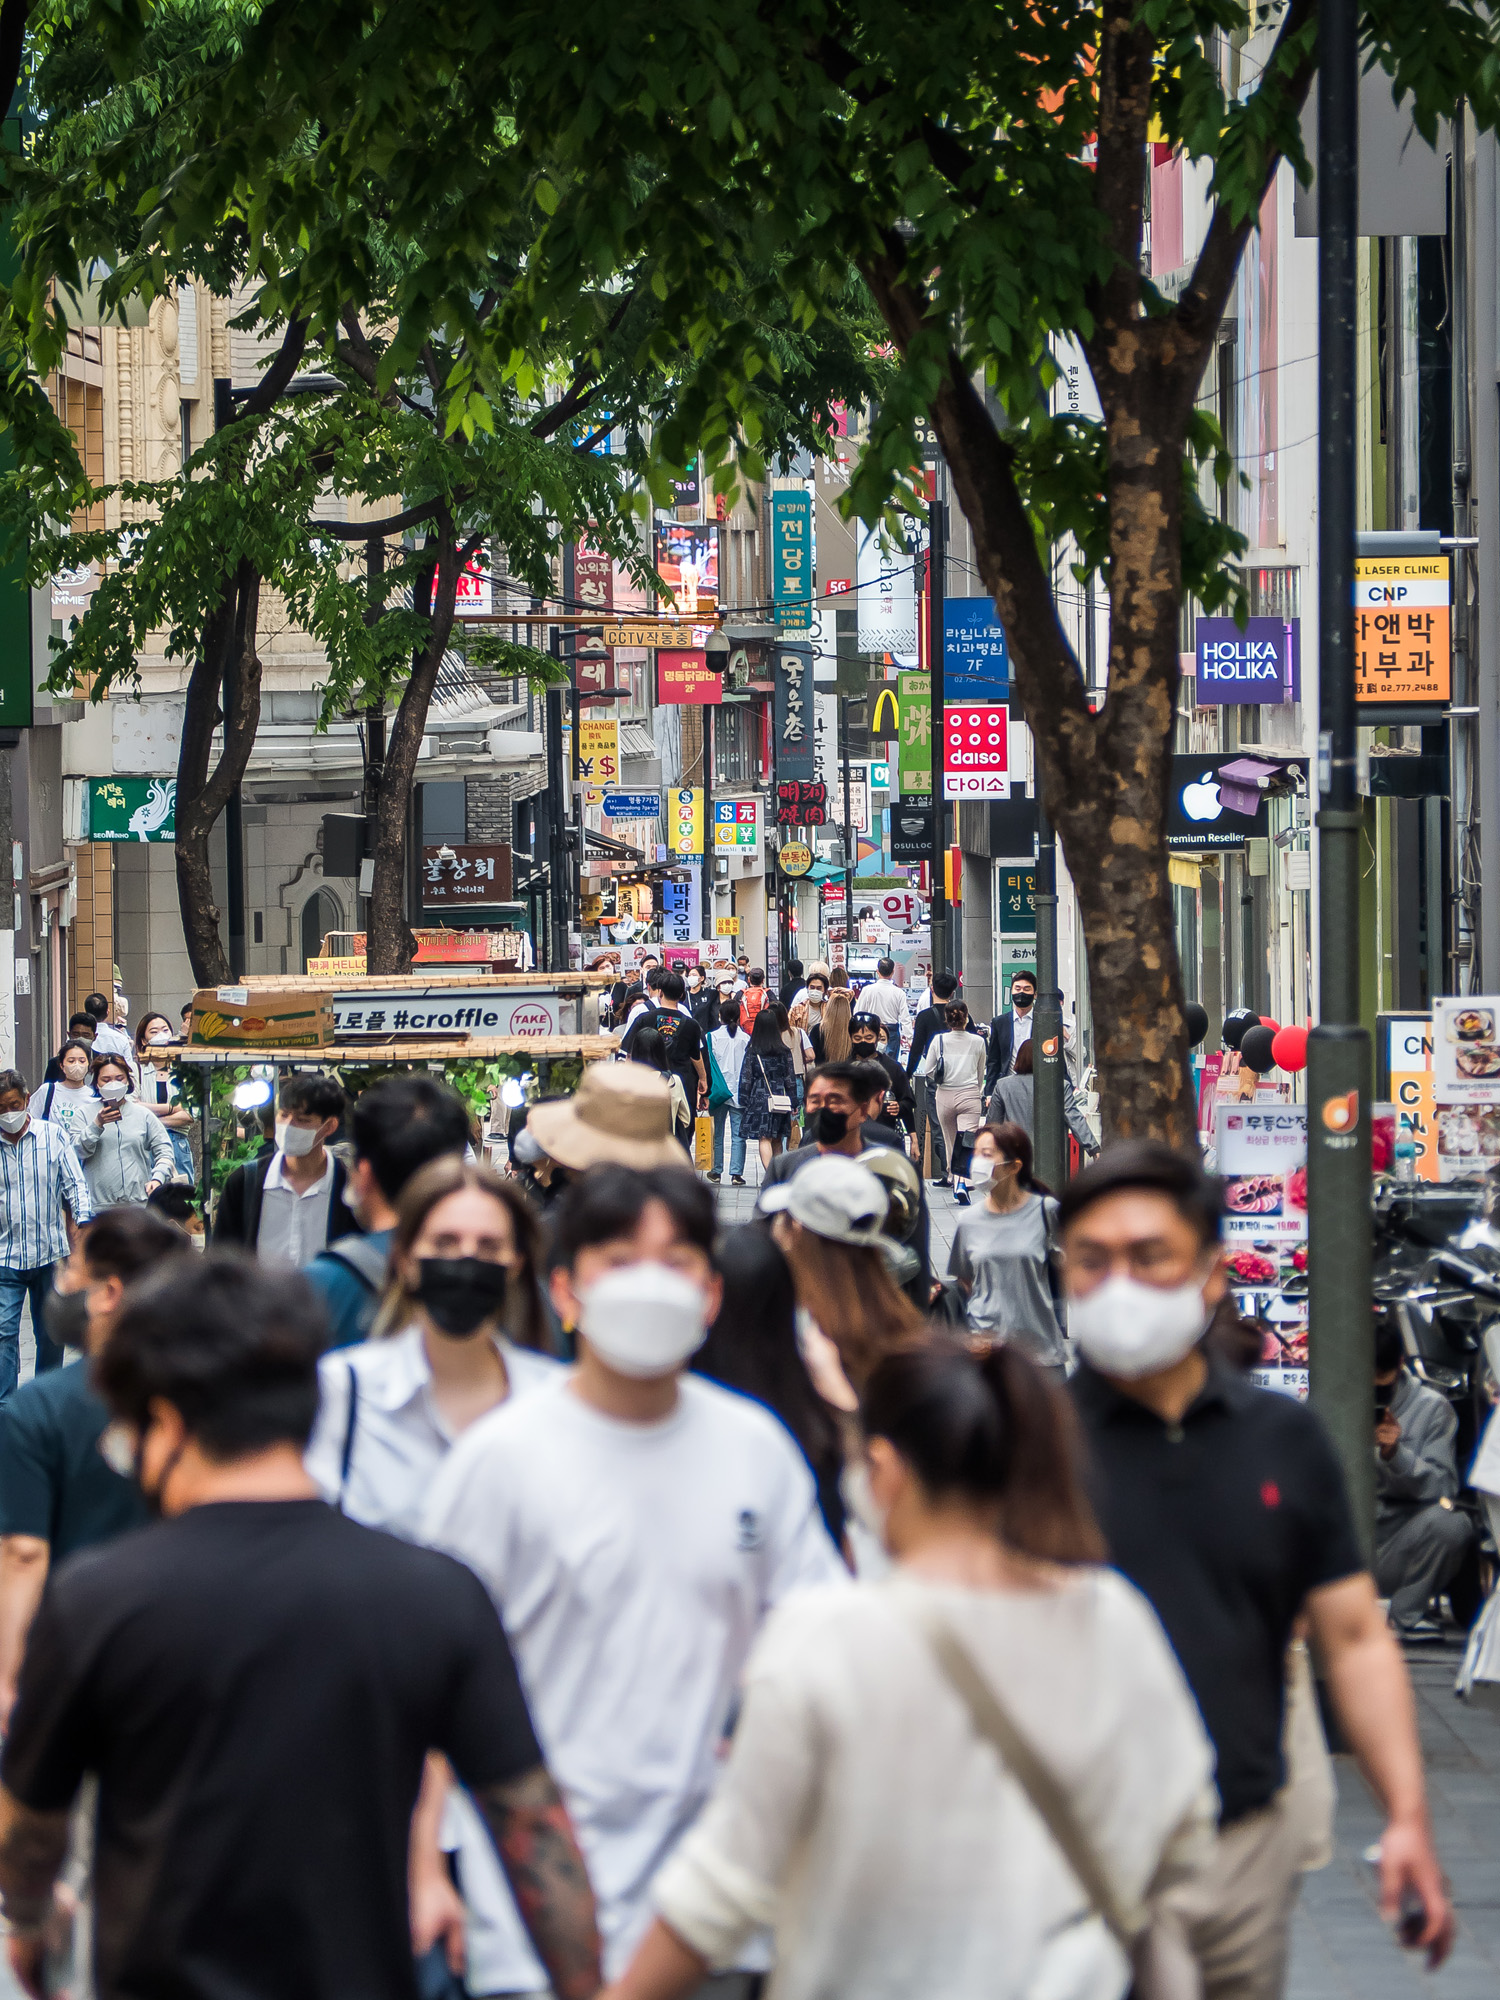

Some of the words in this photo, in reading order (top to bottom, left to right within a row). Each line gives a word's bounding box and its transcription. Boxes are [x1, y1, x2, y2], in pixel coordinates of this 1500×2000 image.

[780, 520, 805, 594] 전당포
[575, 562, 611, 576] 신의주
[1365, 566, 1400, 575] LASER
[1404, 565, 1440, 574] CLINIC
[829, 581, 848, 594] 5G
[1368, 587, 1407, 601] CNP
[608, 632, 689, 645] CCTV작동중
[946, 628, 1003, 640] 라임나무
[946, 643, 1003, 656] 치과병원
[1203, 642, 1278, 660] HOLIKA
[966, 659, 984, 671] 7F
[1203, 662, 1278, 679] HOLIKA
[664, 671, 716, 682] 명동닭갈비
[685, 684, 695, 693] 2F
[1381, 683, 1438, 692] 02.777.2488
[950, 749, 1001, 765] daiso
[947, 777, 1005, 792] 다이소
[904, 795, 932, 807] 오설
[1208, 833, 1245, 843] Reseller
[893, 842, 932, 850] OSULLOC
[780, 851, 810, 864] 부동산
[883, 894, 915, 925] 약
[393, 1007, 498, 1030] #croffle
[514, 1014, 547, 1025] TAKE
